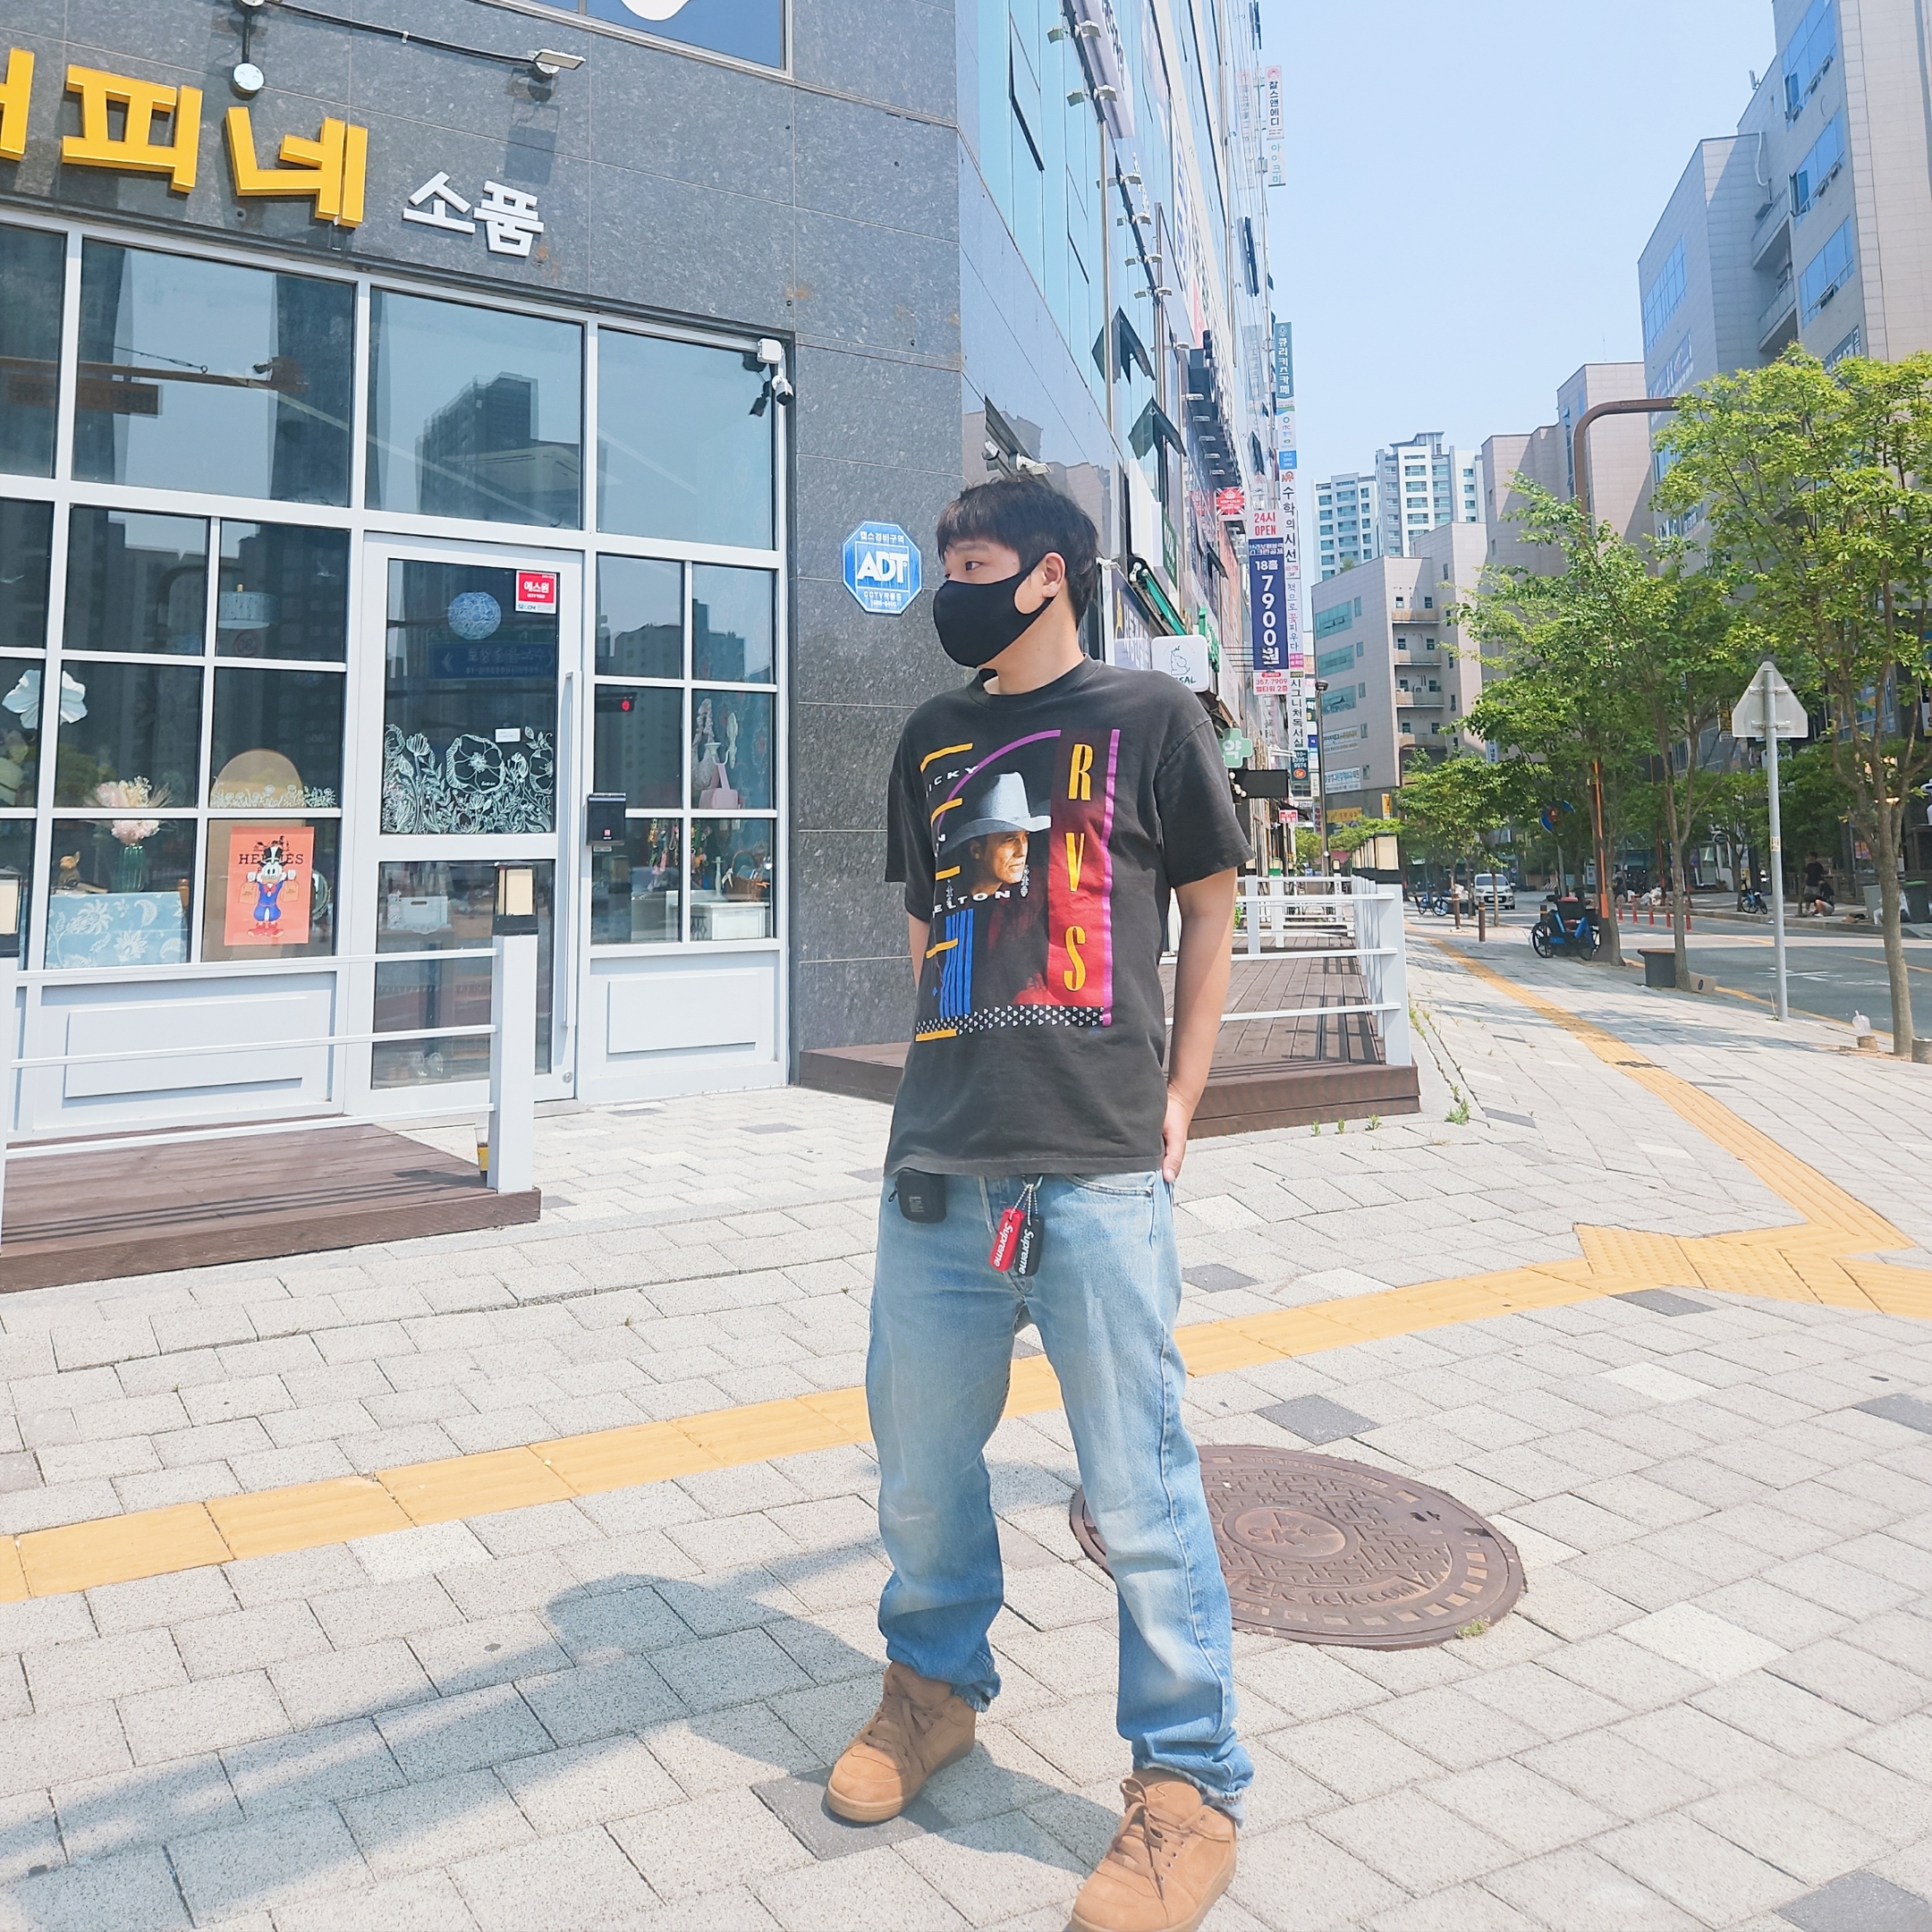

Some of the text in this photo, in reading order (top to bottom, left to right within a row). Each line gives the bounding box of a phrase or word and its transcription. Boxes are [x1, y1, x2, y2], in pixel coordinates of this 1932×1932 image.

[403, 171, 544, 257] 소품
[1254, 513, 1275, 523] 24시
[1255, 525, 1276, 536] OPEN
[856, 550, 909, 584] ADT
[523, 580, 549, 594] 에스원
[1222, 739, 1241, 760] 약
[926, 766, 979, 798] ICKY
[994, 1222, 1013, 1267] Supreme
[1018, 1228, 1035, 1275] Supreme
